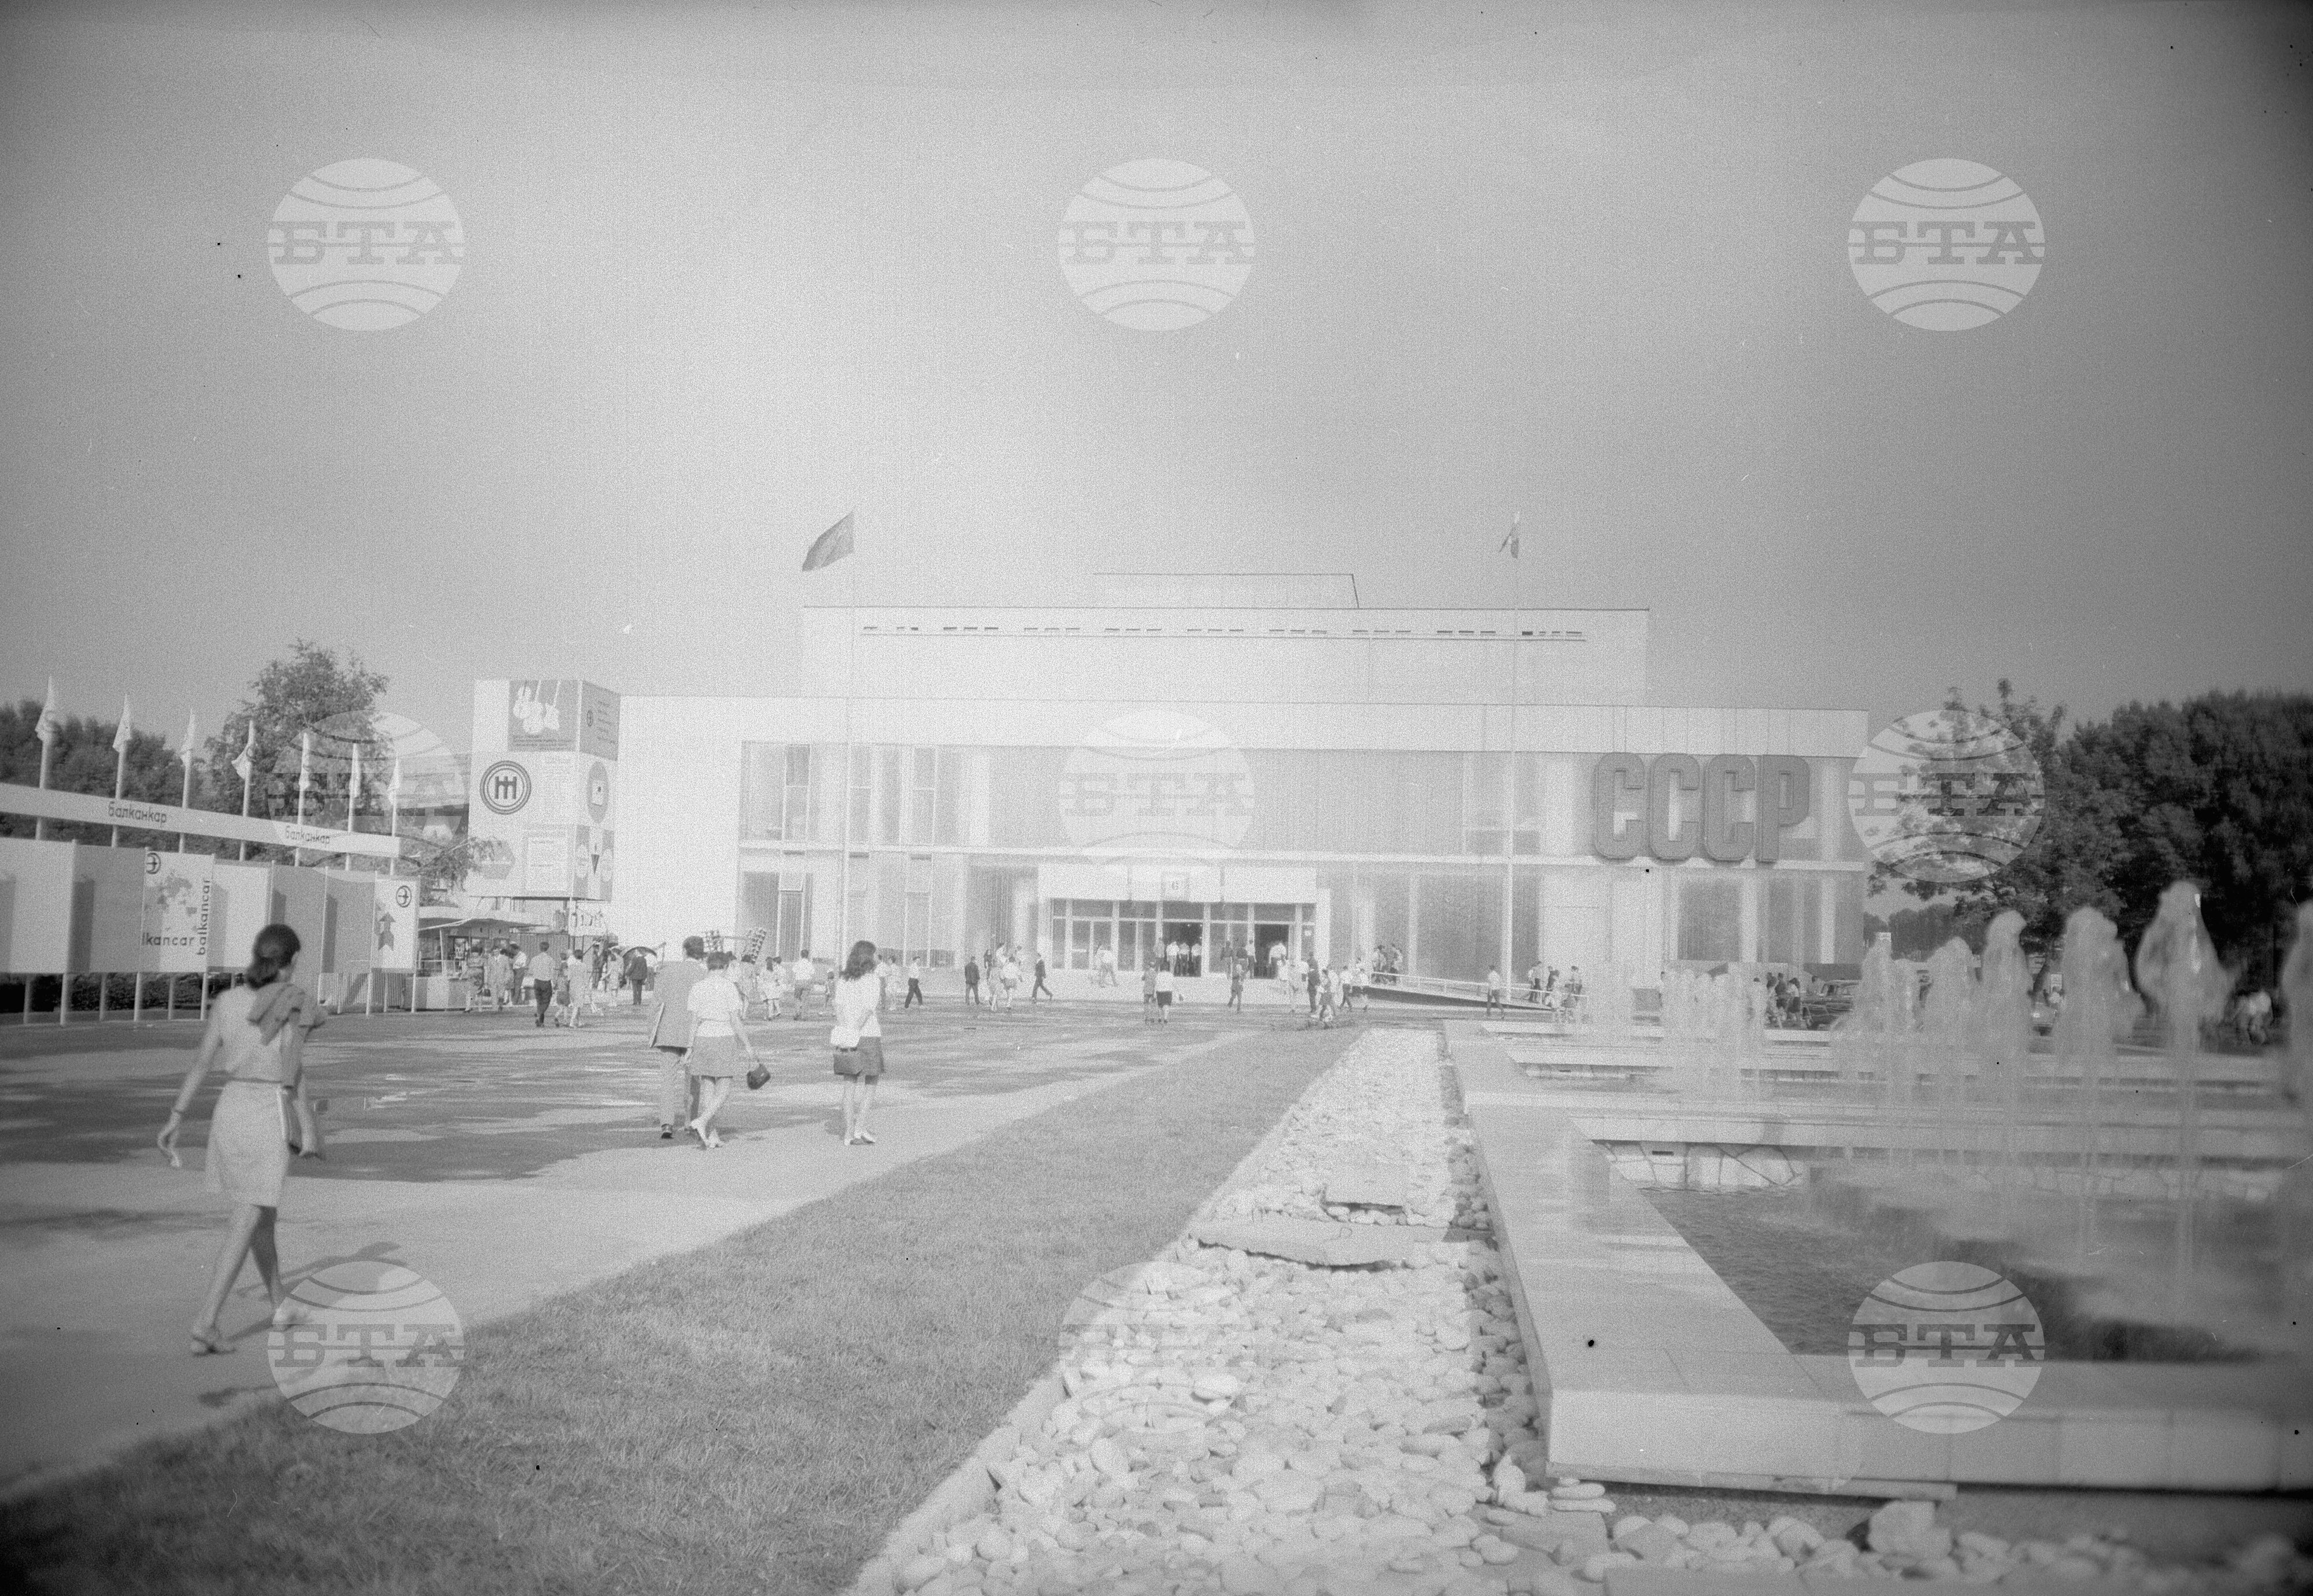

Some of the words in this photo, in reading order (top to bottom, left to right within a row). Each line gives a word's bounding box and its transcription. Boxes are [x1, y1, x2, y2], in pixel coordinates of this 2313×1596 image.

[108, 801, 167, 827] балканкар
[1593, 752, 1810, 863] СССР
[195, 878, 210, 955] balkancar
